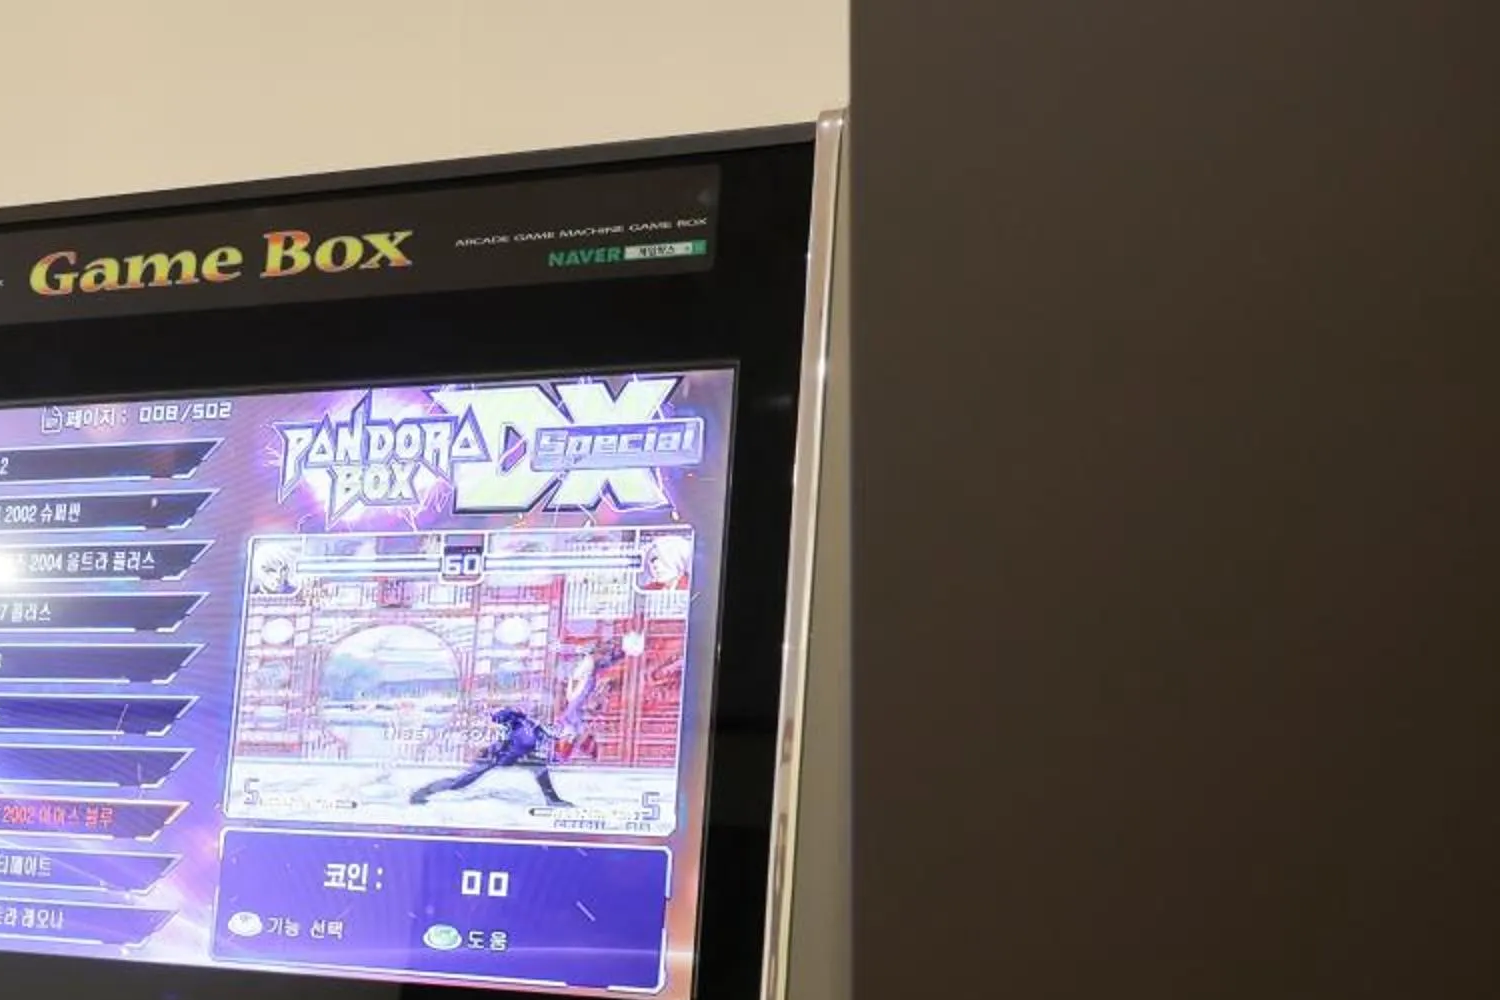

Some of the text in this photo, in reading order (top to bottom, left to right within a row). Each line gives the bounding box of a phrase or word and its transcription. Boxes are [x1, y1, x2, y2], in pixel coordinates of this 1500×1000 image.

[455, 217, 708, 248] ARCADE GAME MACHINE GAME BOX
[29, 228, 414, 298] Game Box
[547, 246, 623, 268] NAVER
[139, 402, 232, 423] 008/502
[275, 388, 490, 503] PANDORA
[428, 376, 683, 513] DX
[537, 420, 696, 464] Special
[0, 458, 8, 474] 2
[327, 458, 422, 529] BOX
[5, 504, 37, 523] 2002
[29, 553, 62, 571] 2004
[446, 555, 479, 577] 60
[3, 805, 35, 825] 2002
[267, 916, 344, 940] 기능 선택
[467, 929, 508, 952] 도움
